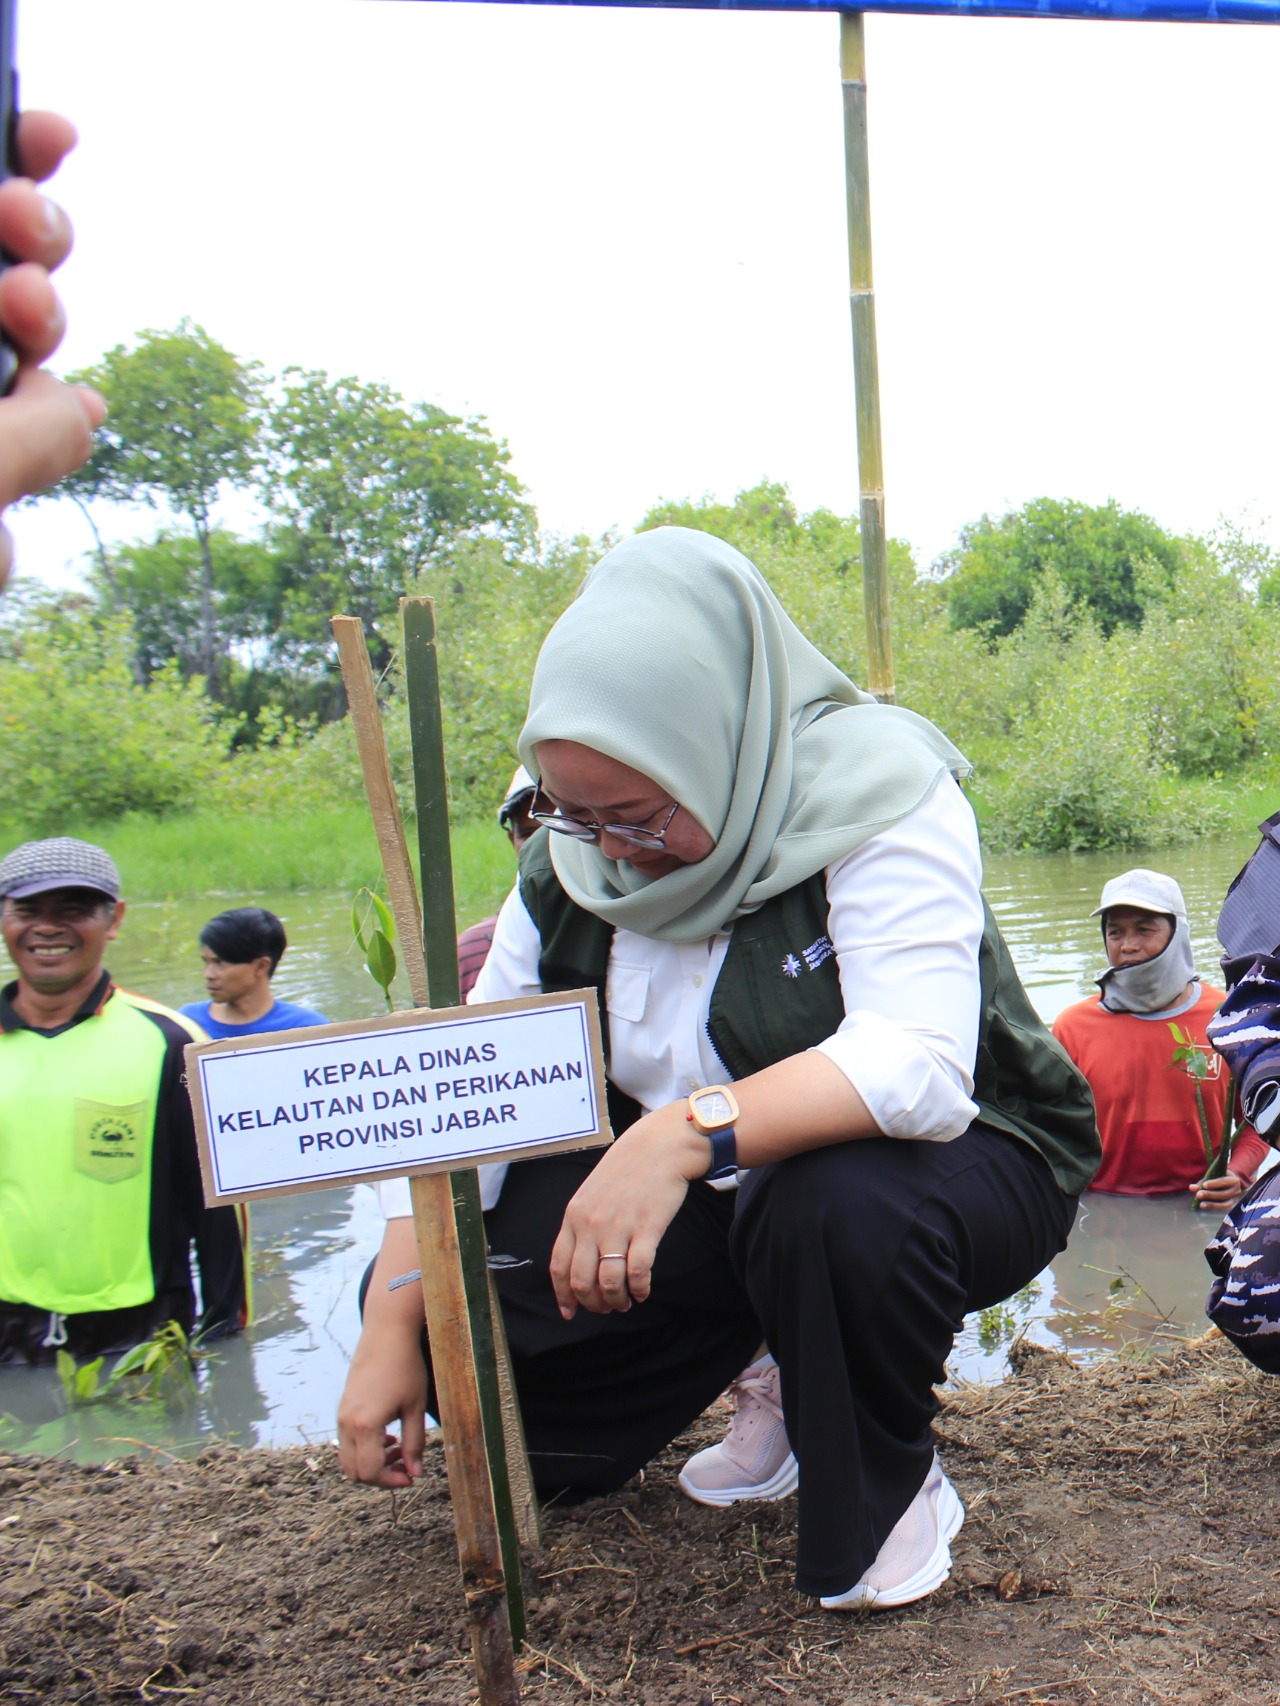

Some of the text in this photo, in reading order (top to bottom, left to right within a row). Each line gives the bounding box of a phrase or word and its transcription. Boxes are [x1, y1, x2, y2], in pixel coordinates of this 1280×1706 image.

[303, 1043, 497, 1088] KEPALA DINAS
[218, 1061, 583, 1134] KELAUTAN DAN PERIKANAN
[299, 1104, 518, 1154] PROVINSI JABAR
